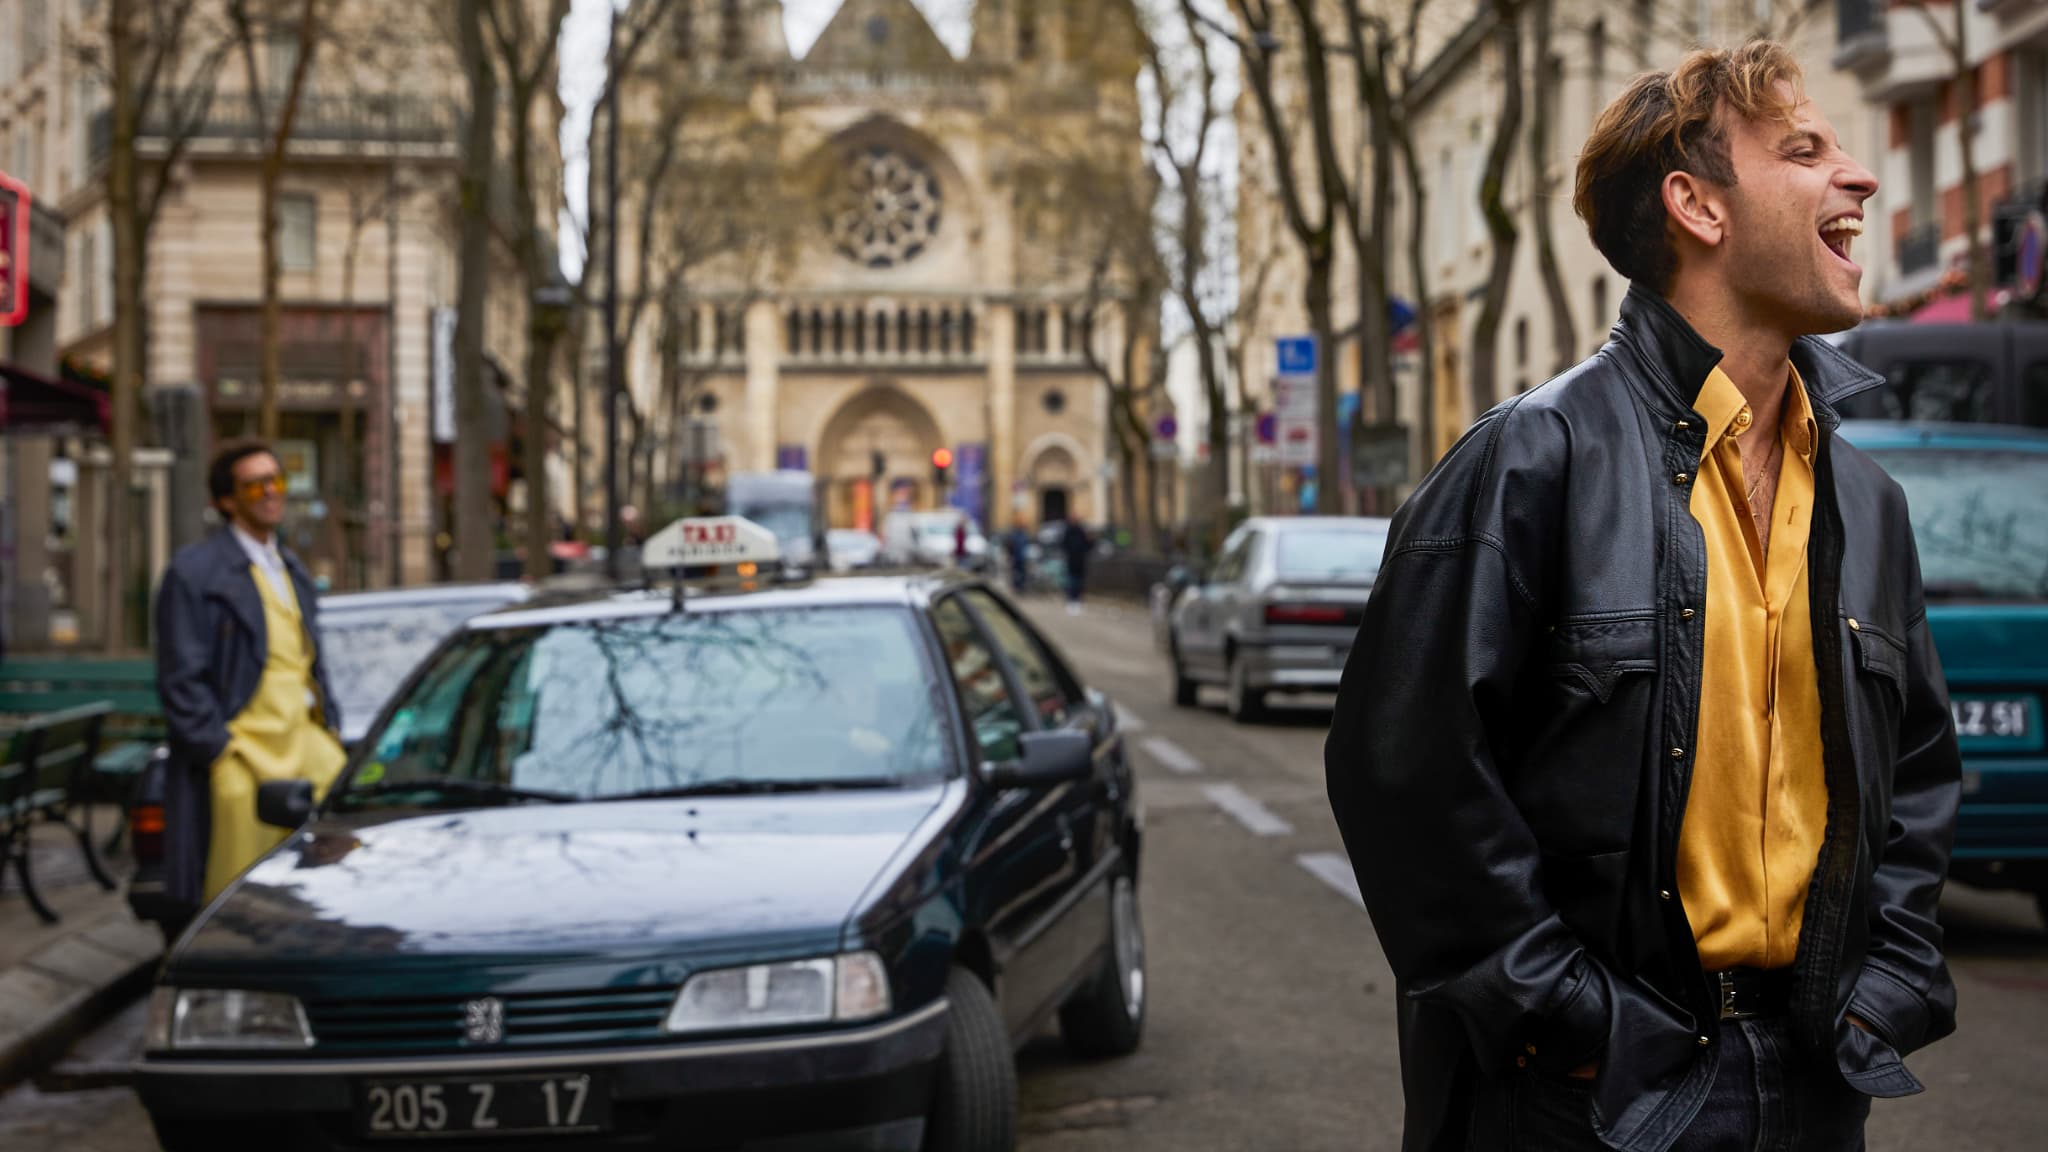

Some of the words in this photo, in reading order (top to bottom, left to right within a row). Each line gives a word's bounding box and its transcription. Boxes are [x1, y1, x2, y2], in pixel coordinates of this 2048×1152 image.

[683, 524, 736, 544] TAXI
[1991, 701, 2024, 736] 51
[368, 1086, 447, 1130] 205
[469, 1083, 498, 1128] Z
[541, 1079, 590, 1126] 17
